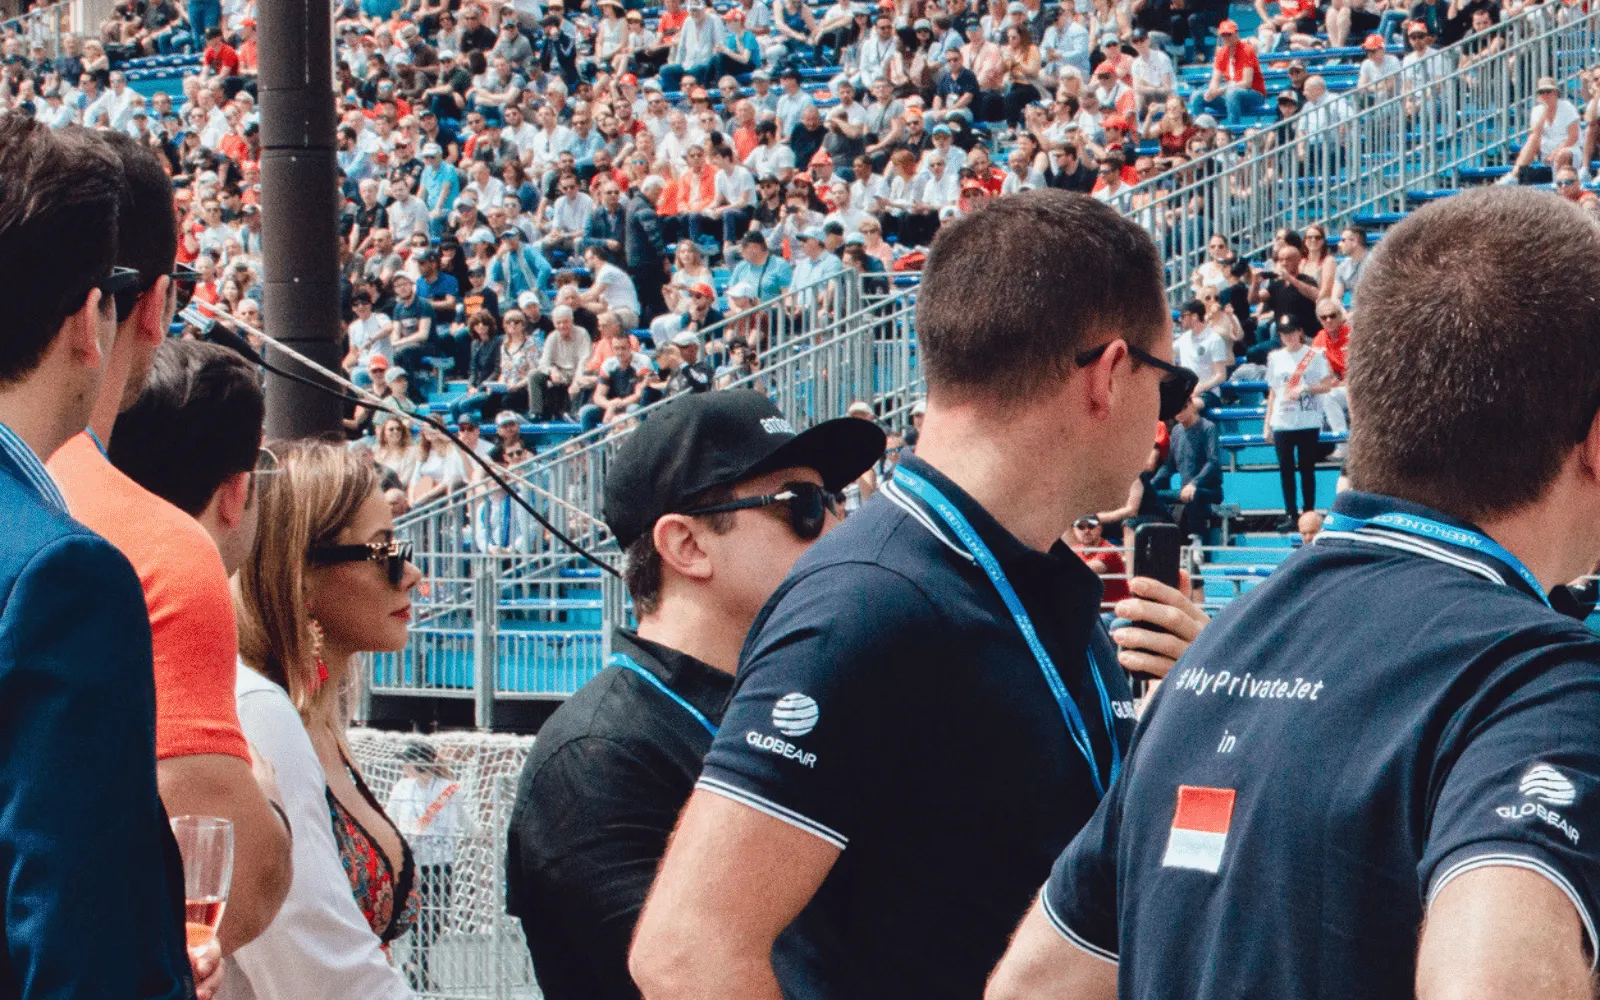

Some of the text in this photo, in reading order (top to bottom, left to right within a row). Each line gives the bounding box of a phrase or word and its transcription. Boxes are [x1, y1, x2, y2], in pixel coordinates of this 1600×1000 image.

[1176, 667, 1324, 700] #MyPrivateJet
[746, 731, 817, 769] GLOBEAIR
[1217, 729, 1236, 753] in
[1495, 802, 1580, 846] GLOBEAIR
